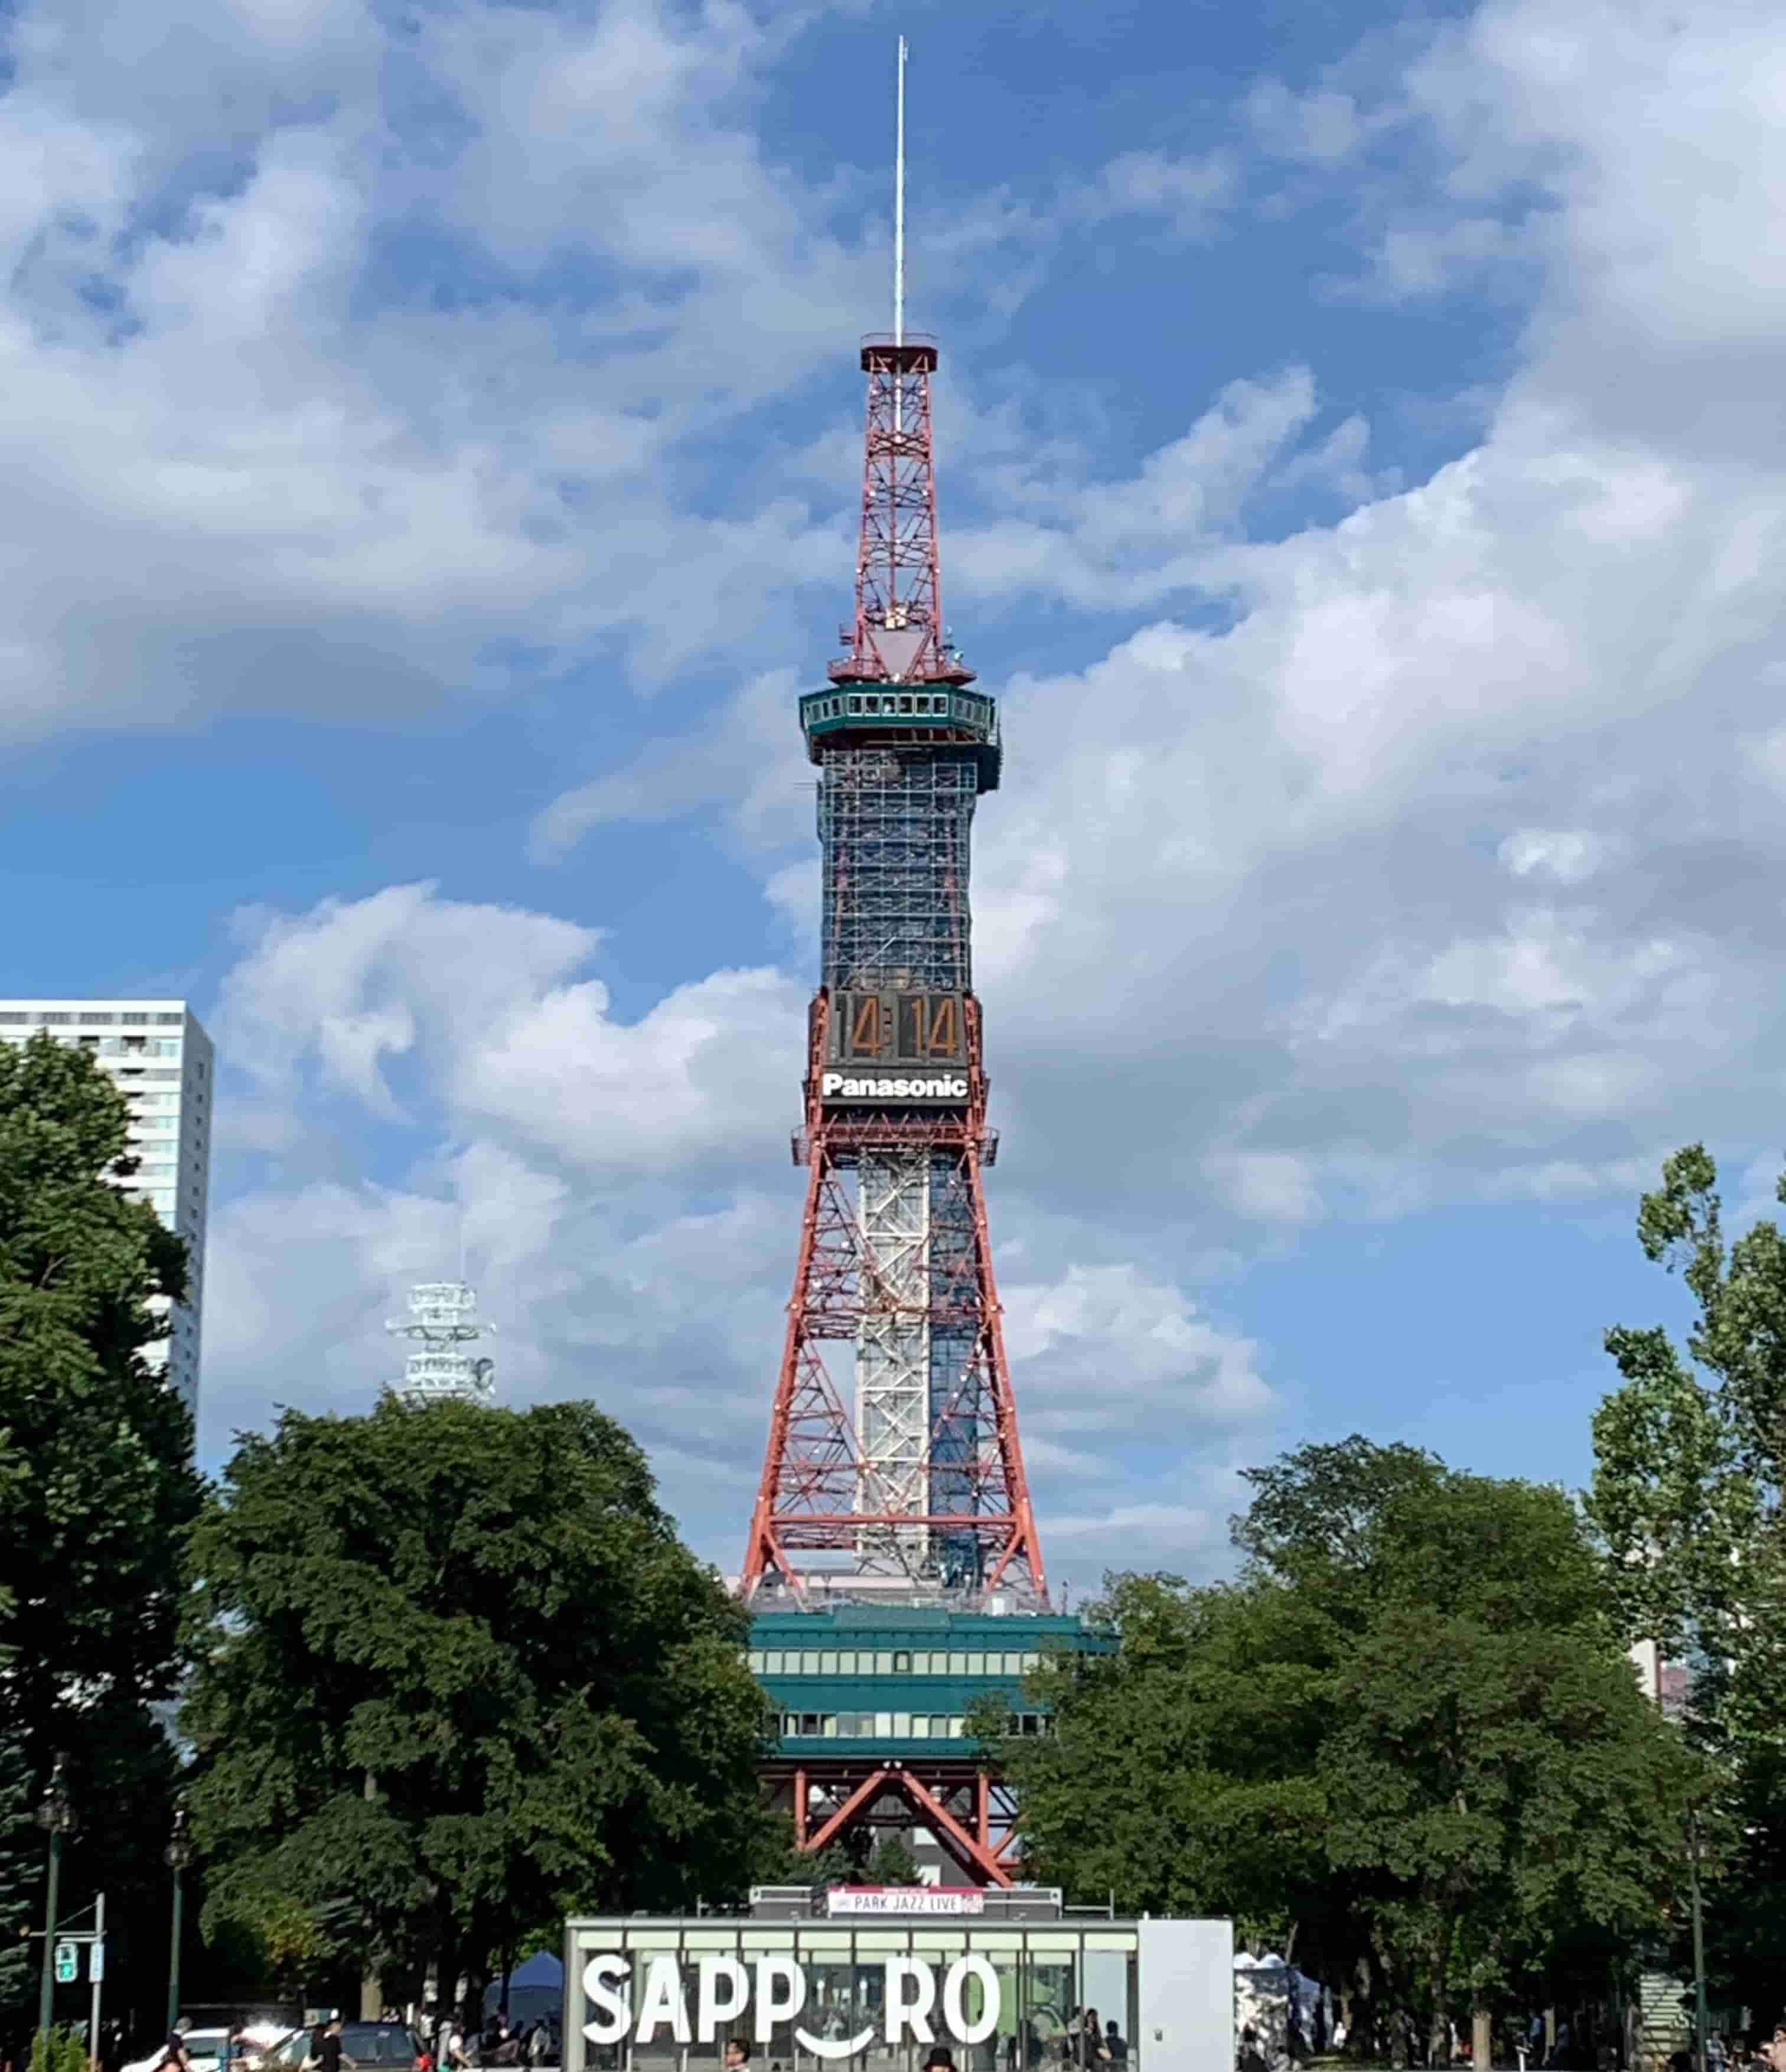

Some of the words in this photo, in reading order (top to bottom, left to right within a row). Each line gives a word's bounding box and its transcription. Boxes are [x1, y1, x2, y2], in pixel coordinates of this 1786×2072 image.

[823, 1073, 967, 1097] Panasonic
[855, 1895, 887, 1910] PARK
[893, 1896, 923, 1910] JAZZ
[930, 1897, 956, 1911] LIVE
